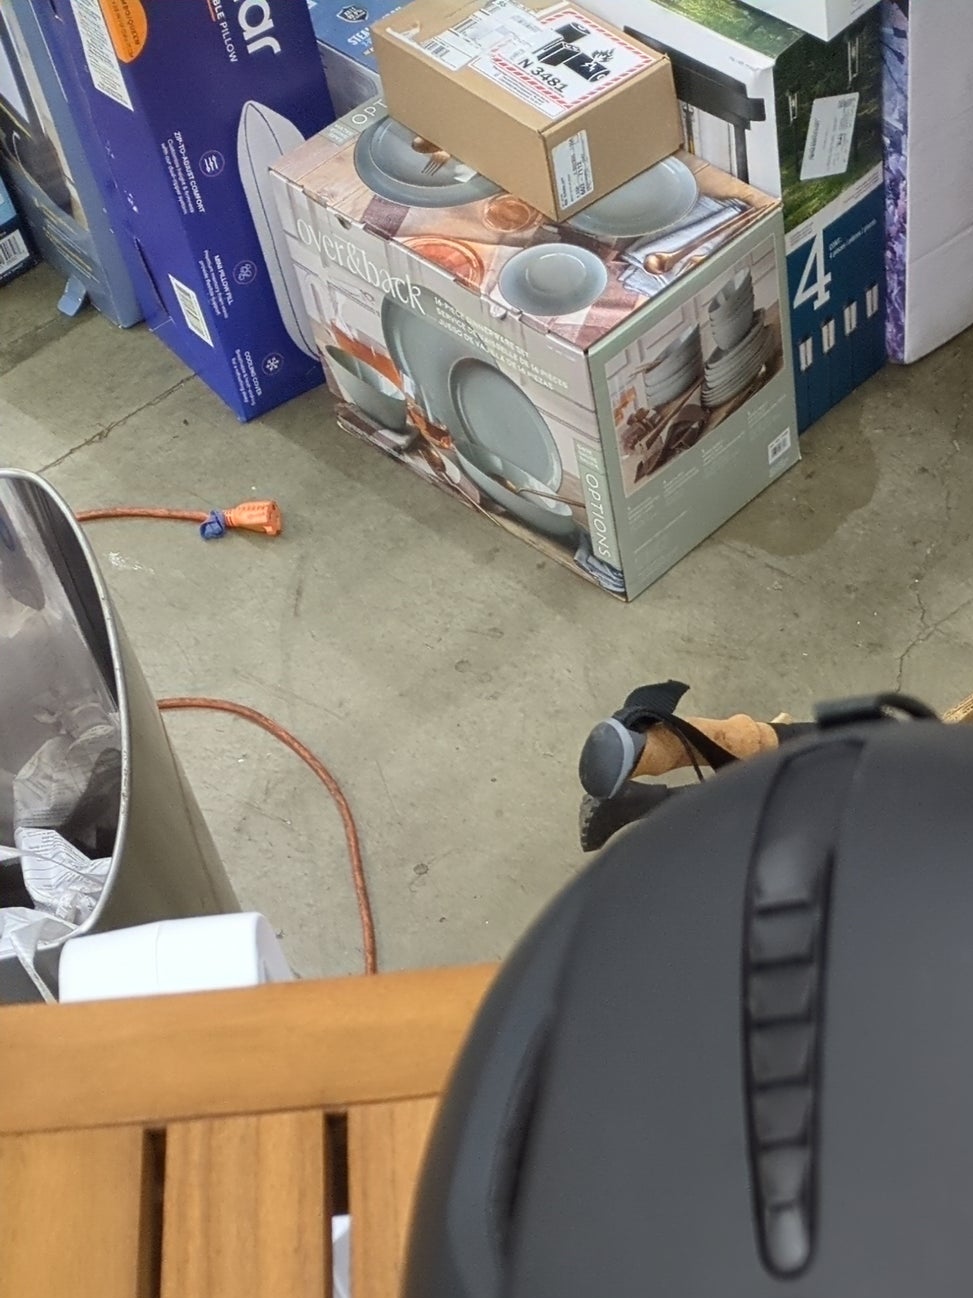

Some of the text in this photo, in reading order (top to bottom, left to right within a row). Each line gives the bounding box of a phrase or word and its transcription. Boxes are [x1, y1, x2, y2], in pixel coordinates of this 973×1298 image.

[219, 20, 238, 63] PILLOW
[531, 65, 569, 94] 3481
[189, 180, 206, 213] COMFORT
[217, 268, 230, 292] PILLOW
[296, 218, 425, 315] over&back
[793, 226, 832, 311] 4
[586, 473, 611, 558] OPTIONS
